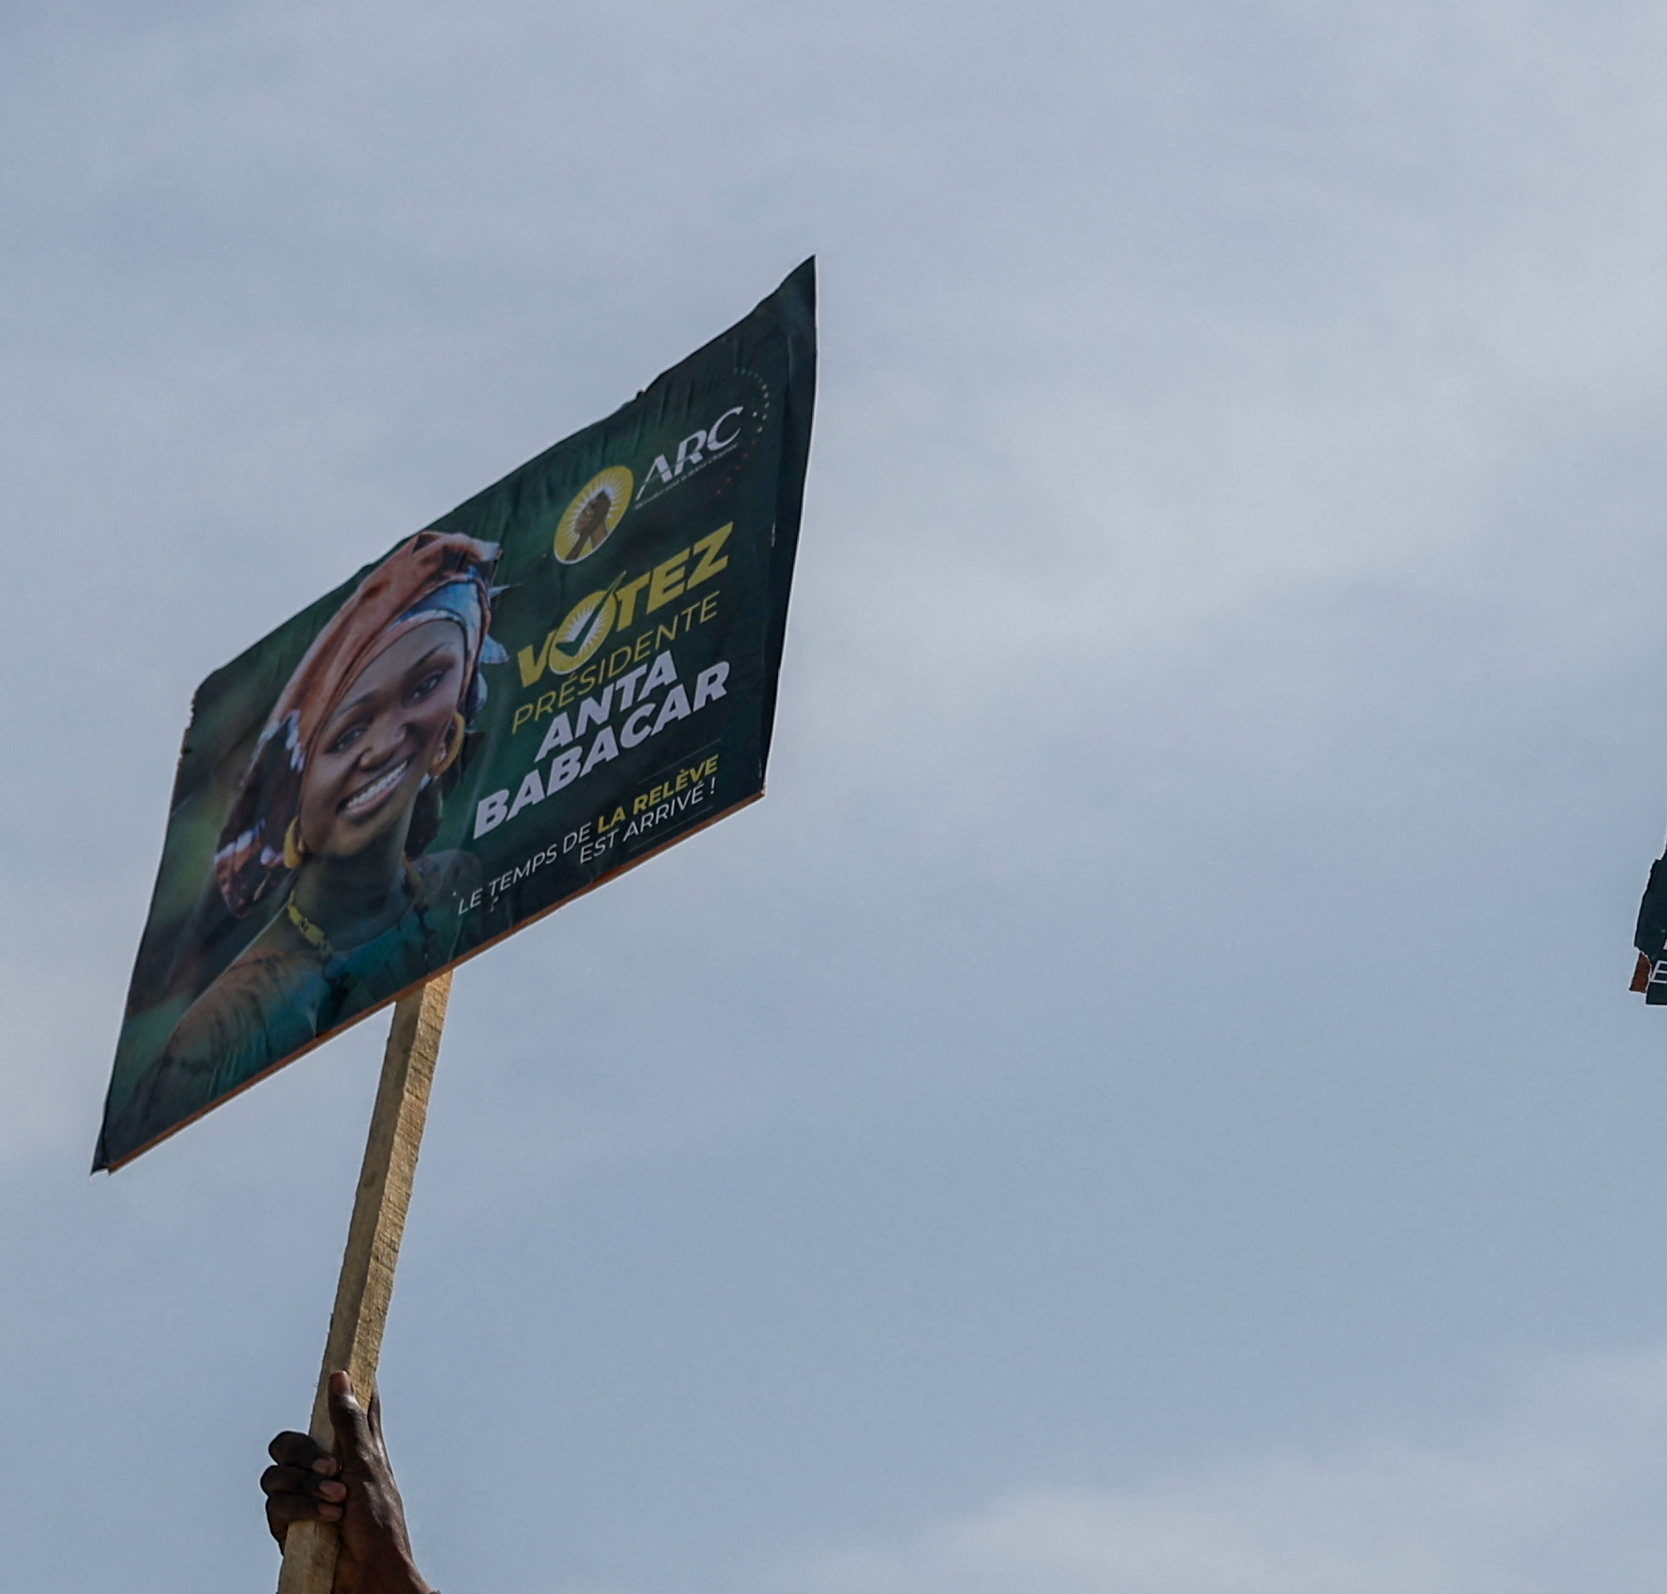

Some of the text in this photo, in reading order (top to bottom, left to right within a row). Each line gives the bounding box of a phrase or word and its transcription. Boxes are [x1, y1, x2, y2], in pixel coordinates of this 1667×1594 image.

[636, 406, 743, 501] ARC
[511, 590, 721, 735] PRÉSIDENTE
[517, 520, 734, 688] VOTEZ
[473, 661, 731, 840] BABACAR
[533, 649, 678, 764] ANTA
[457, 754, 719, 915] LE TEMPS DE LA RELÈVE
[578, 831, 620, 865] EST
[622, 782, 706, 843] ARRIVÉ
